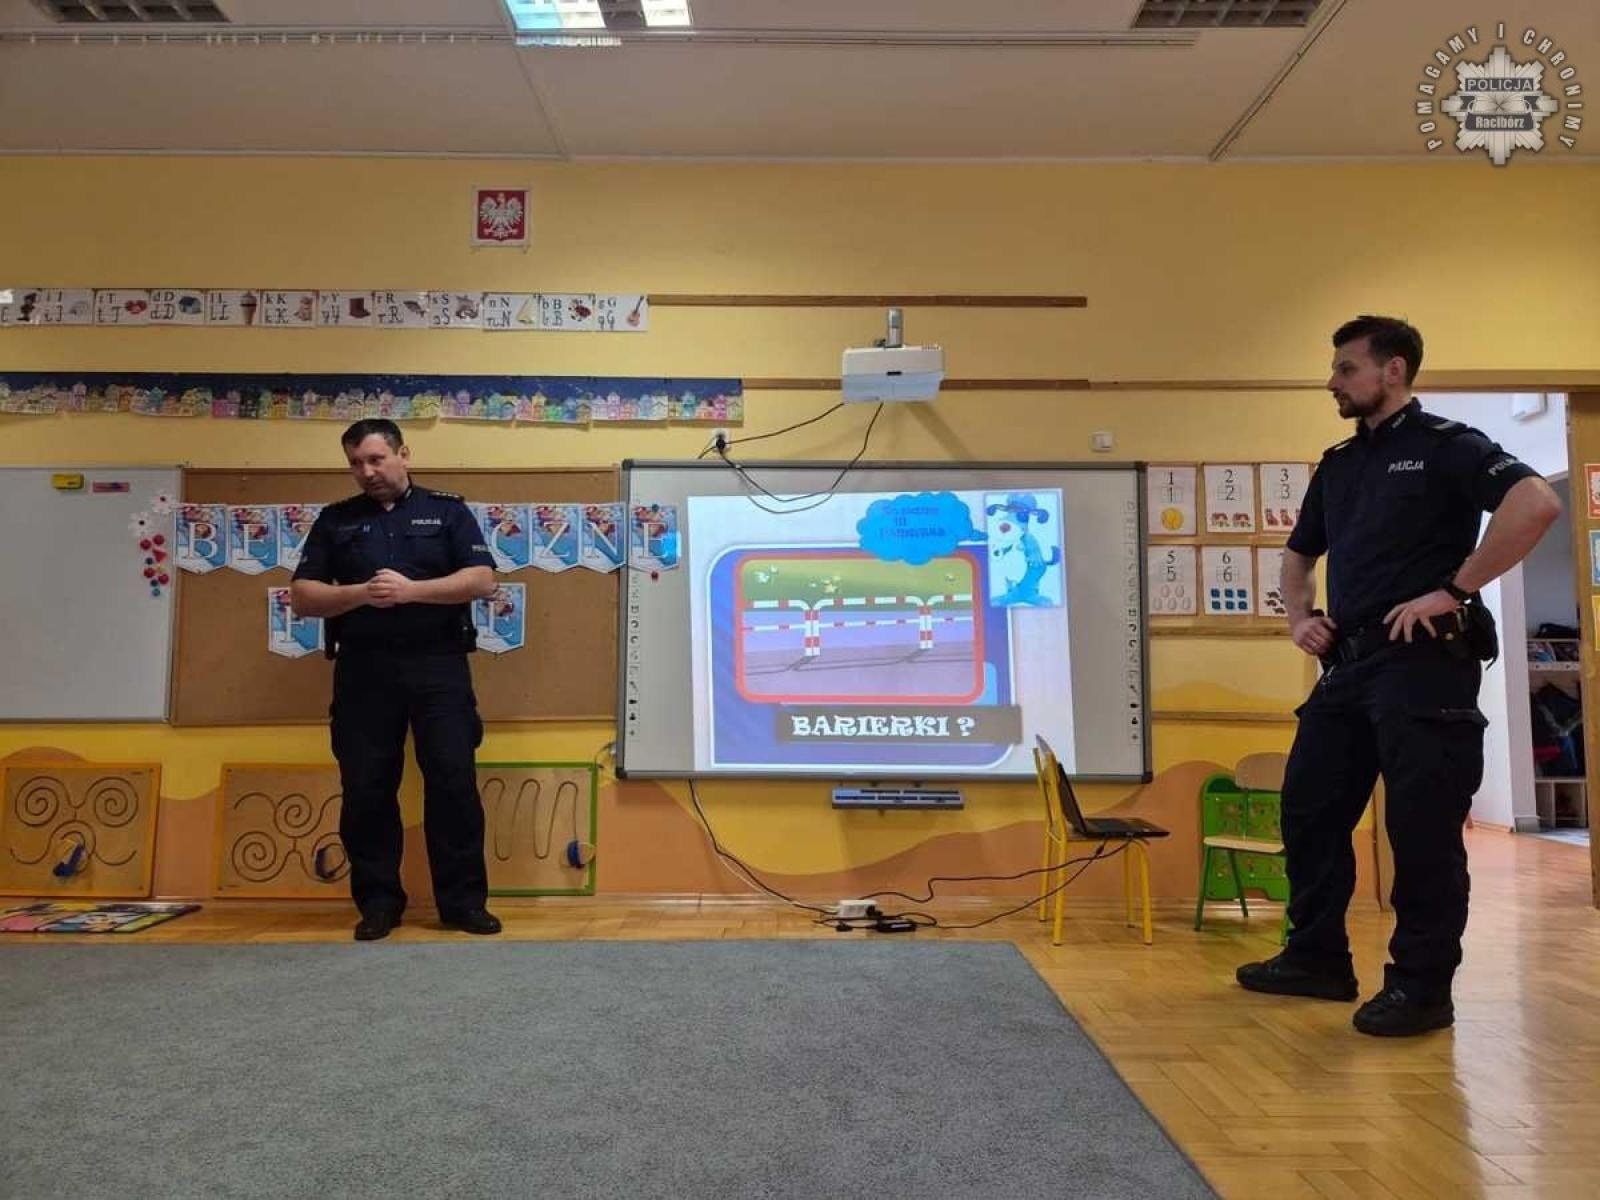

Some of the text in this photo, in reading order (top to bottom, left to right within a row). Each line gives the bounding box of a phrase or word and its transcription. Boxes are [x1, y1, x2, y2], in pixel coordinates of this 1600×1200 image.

[1168, 471, 1174, 485] 1
[1224, 469, 1233, 483] 2
[1280, 468, 1289, 482] 3
[1168, 487, 1174, 502] 1
[1226, 485, 1237, 501] 2
[1280, 484, 1290, 500] 3
[1166, 550, 1175, 565] 5
[1222, 551, 1231, 565] 6
[1166, 566, 1177, 583] 5
[1223, 566, 1233, 583] 6
[791, 715, 976, 737] BARIERKI ?
